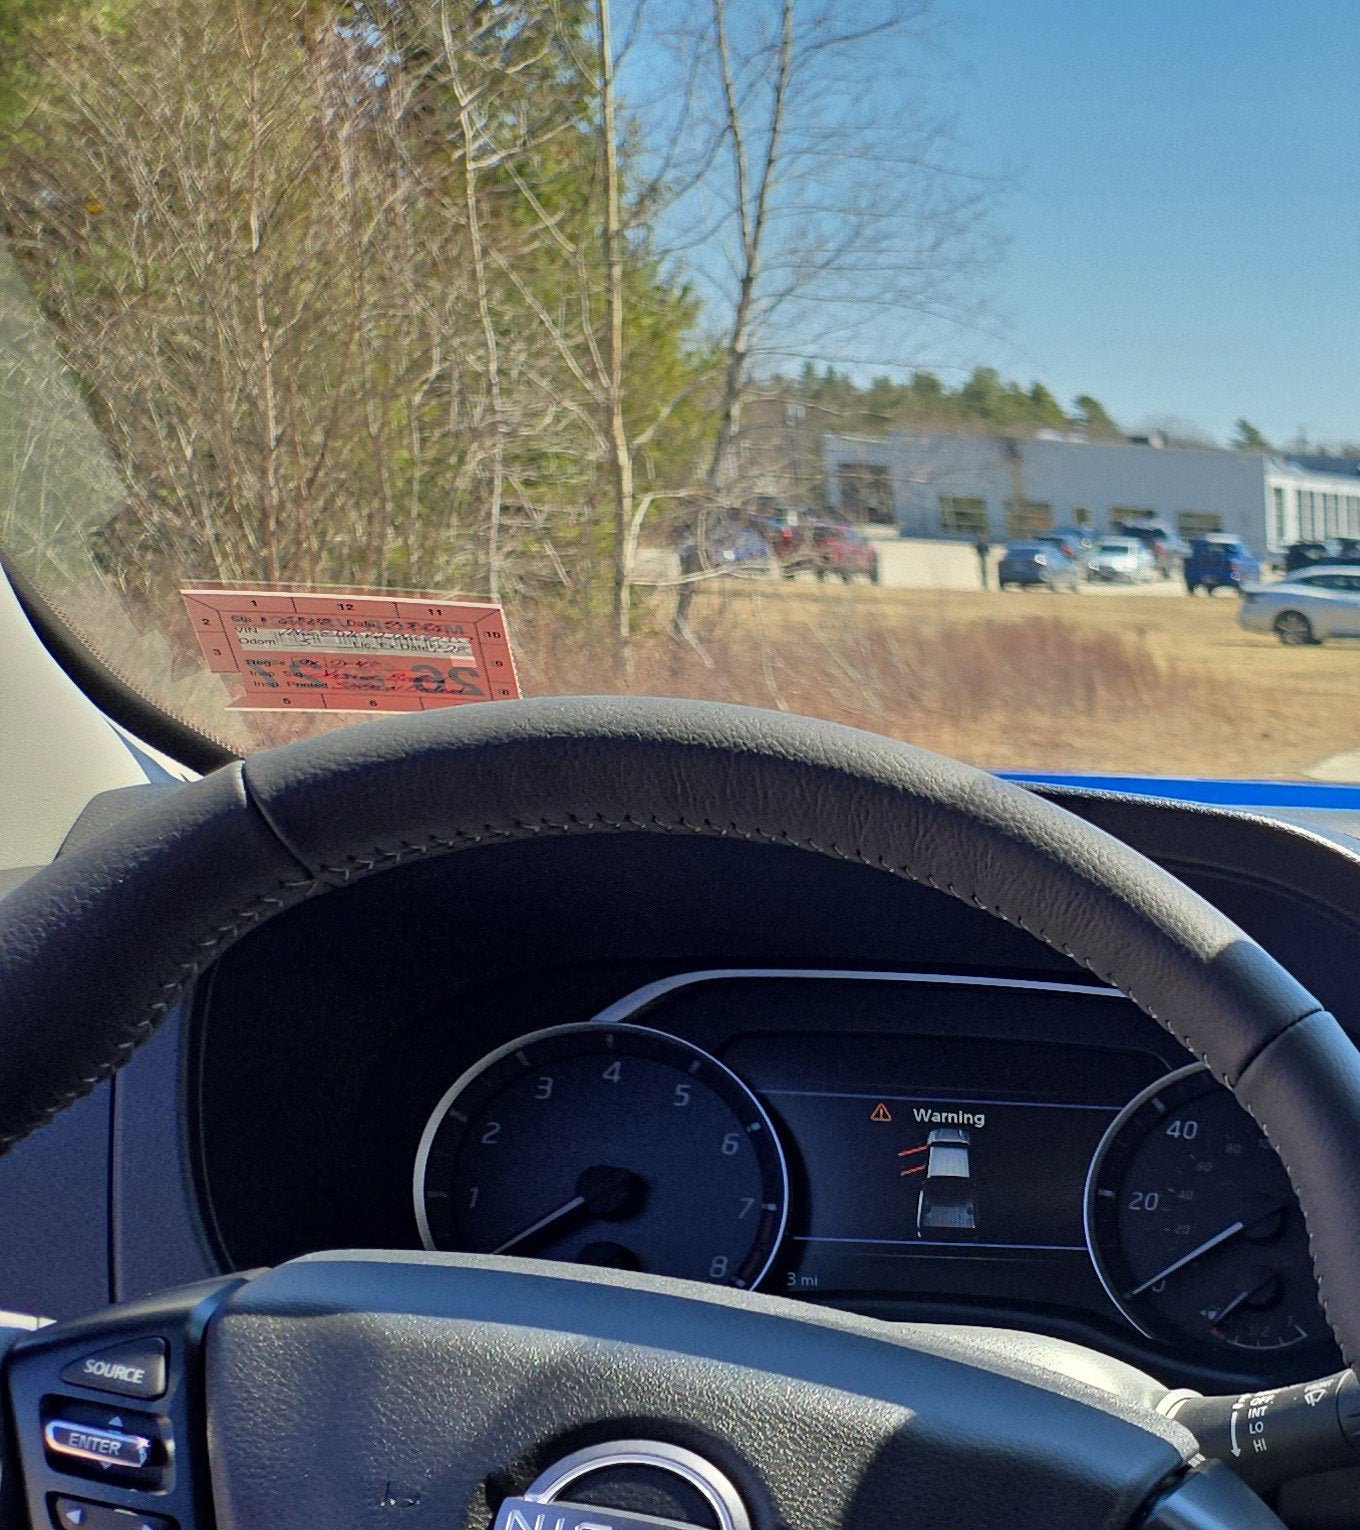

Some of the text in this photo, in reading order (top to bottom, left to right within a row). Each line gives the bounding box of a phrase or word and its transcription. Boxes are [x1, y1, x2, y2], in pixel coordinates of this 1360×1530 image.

[201, 618, 211, 626] 2
[427, 608, 442, 616] 11
[483, 631, 501, 639] 10
[213, 648, 222, 656] 3
[602, 1061, 621, 1082] 4
[534, 1077, 553, 1099] 3
[673, 1083, 690, 1106] 5
[913, 1107, 986, 1129] Warning
[480, 1122, 500, 1144] 2
[1165, 1120, 1199, 1140] 40
[721, 1133, 739, 1155] 6
[469, 1186, 478, 1208] 1
[1129, 1191, 1159, 1211] 20
[738, 1197, 755, 1219] 7
[709, 1255, 728, 1278] 8
[787, 1272, 818, 1286] 3 mi
[83, 1359, 146, 1384] SOURCE
[1248, 1405, 1268, 1419] INT
[1249, 1421, 1264, 1435] LO
[69, 1432, 121, 1456] ENTER
[1253, 1438, 1267, 1452] HI
